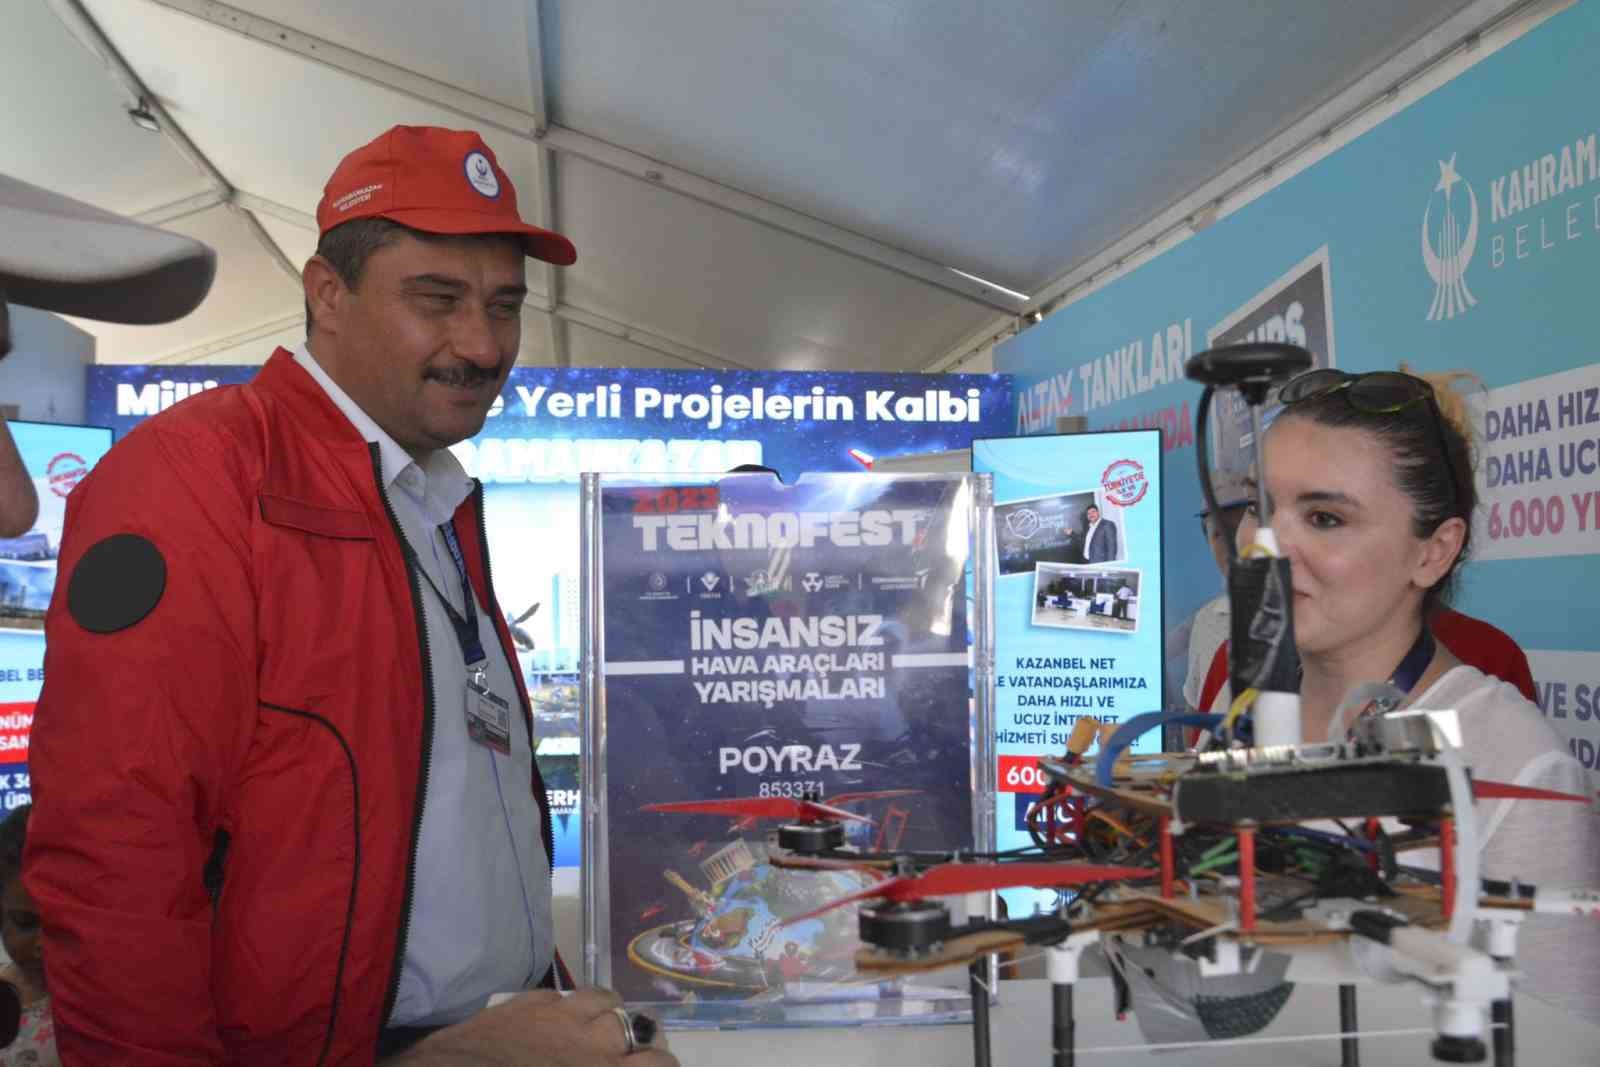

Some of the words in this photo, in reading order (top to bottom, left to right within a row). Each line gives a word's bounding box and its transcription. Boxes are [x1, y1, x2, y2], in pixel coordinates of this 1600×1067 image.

[1491, 132, 1600, 223] KAHRAM
[1080, 318, 1192, 412] TANKLARI
[117, 379, 219, 416] Mil
[515, 383, 622, 418] Yerli
[634, 384, 854, 430] Projelerin
[865, 388, 981, 423] Kalbi
[1016, 369, 1073, 436] ALTAY
[1485, 399, 1551, 442] DAHA
[1485, 448, 1553, 488] DAHA
[1558, 438, 1600, 478] UC
[632, 509, 922, 552] TEKNOFEST
[1487, 495, 1565, 541] 6.000
[690, 610, 885, 651] İNSANSIZ
[691, 655, 760, 676] HAVA
[763, 652, 885, 678] ARAÇLARI
[1009, 675, 1148, 692] VATANDAŞLARIMIZA
[1016, 656, 1086, 670] KAZANBEL
[1090, 657, 1117, 670] NET
[693, 677, 886, 709] YARIŞMALARI
[1017, 694, 1057, 707] DAHA
[1060, 695, 1093, 708] HIZLI
[1096, 695, 1115, 708] VE
[1013, 713, 1053, 726] UCUZ
[719, 743, 862, 774] POYRAZ
